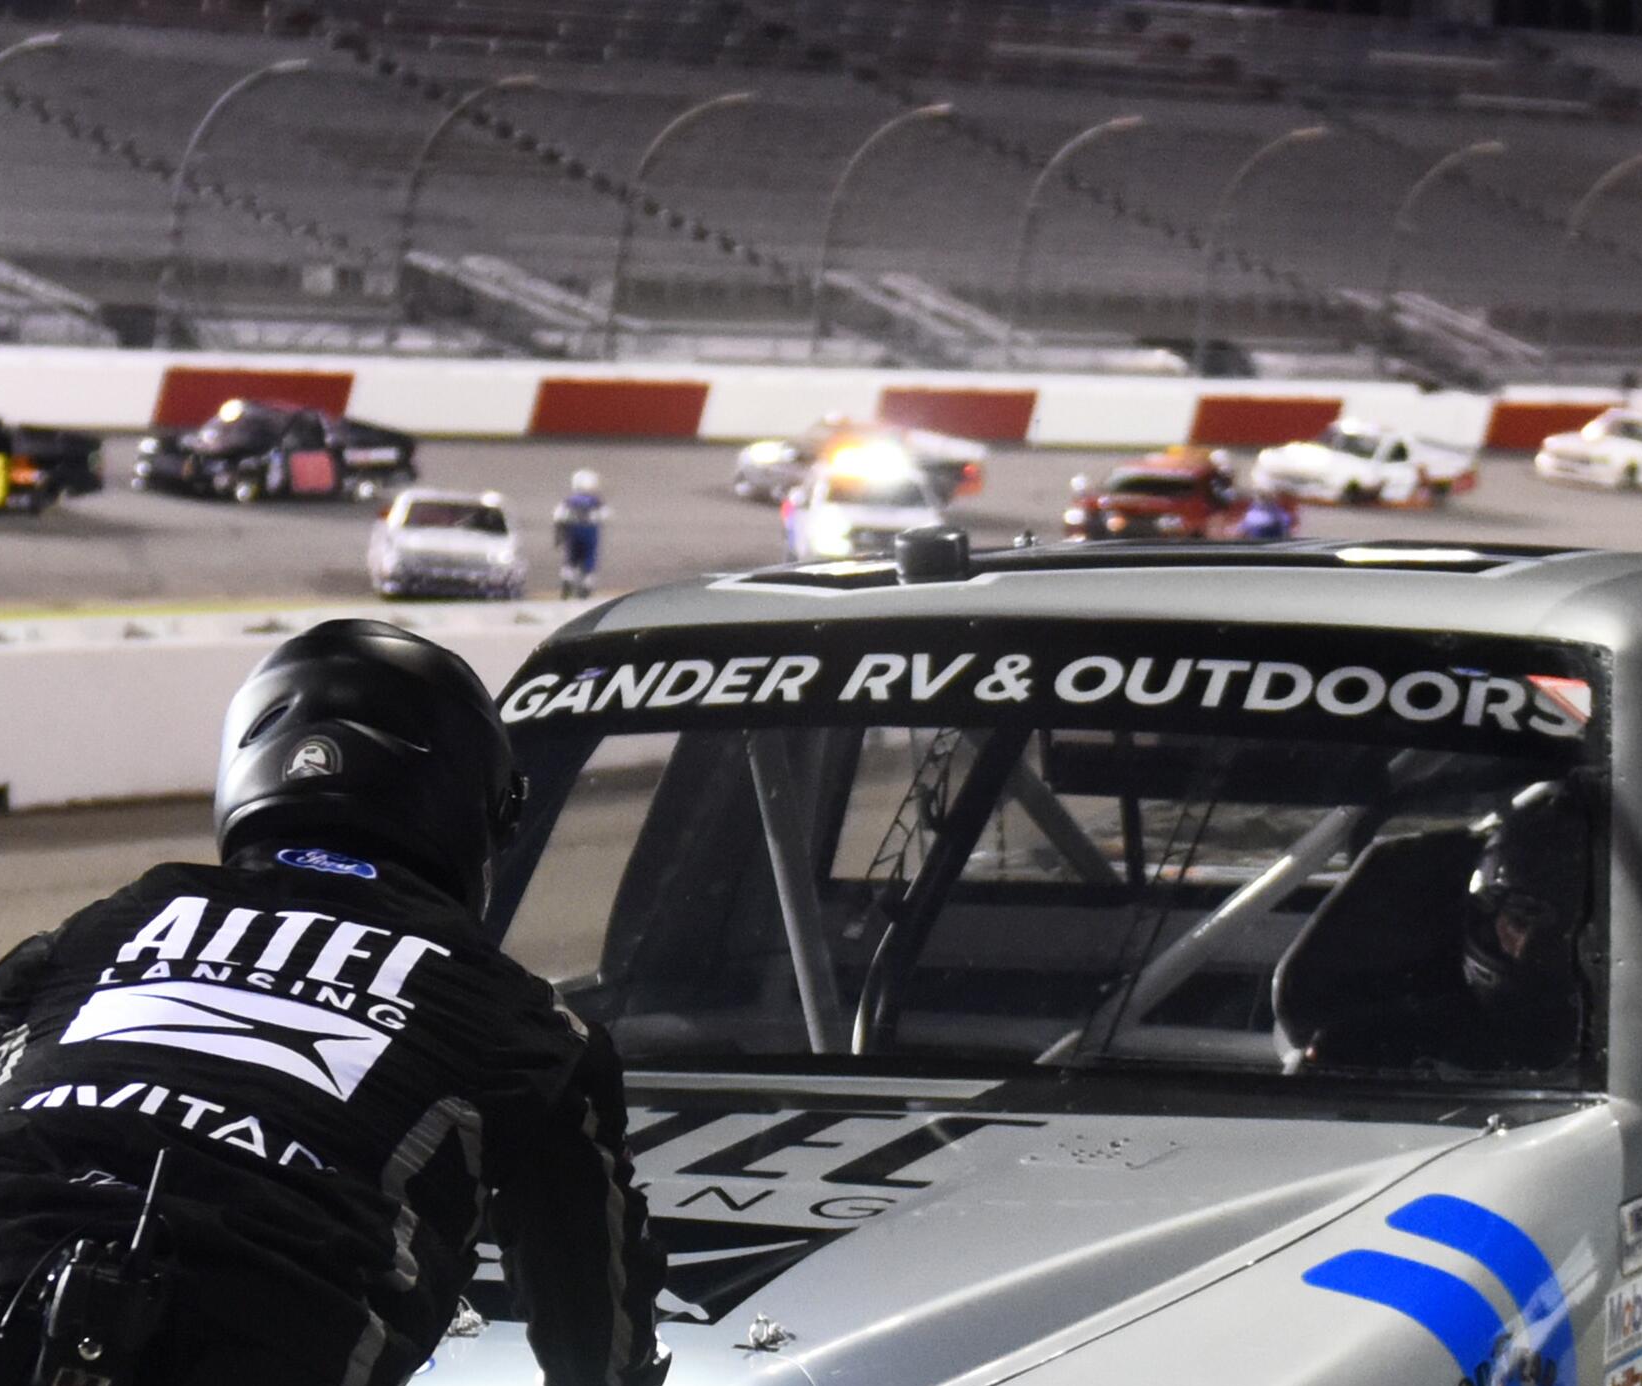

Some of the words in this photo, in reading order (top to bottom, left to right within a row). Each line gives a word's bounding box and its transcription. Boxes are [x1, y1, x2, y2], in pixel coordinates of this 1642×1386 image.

[499, 654, 822, 725] GANDER
[838, 652, 977, 701] RV
[973, 653, 1034, 702] &
[1054, 654, 1587, 739] OUTDOORS
[96, 960, 408, 1030] LANSING
[115, 895, 451, 1010] ALTEC
